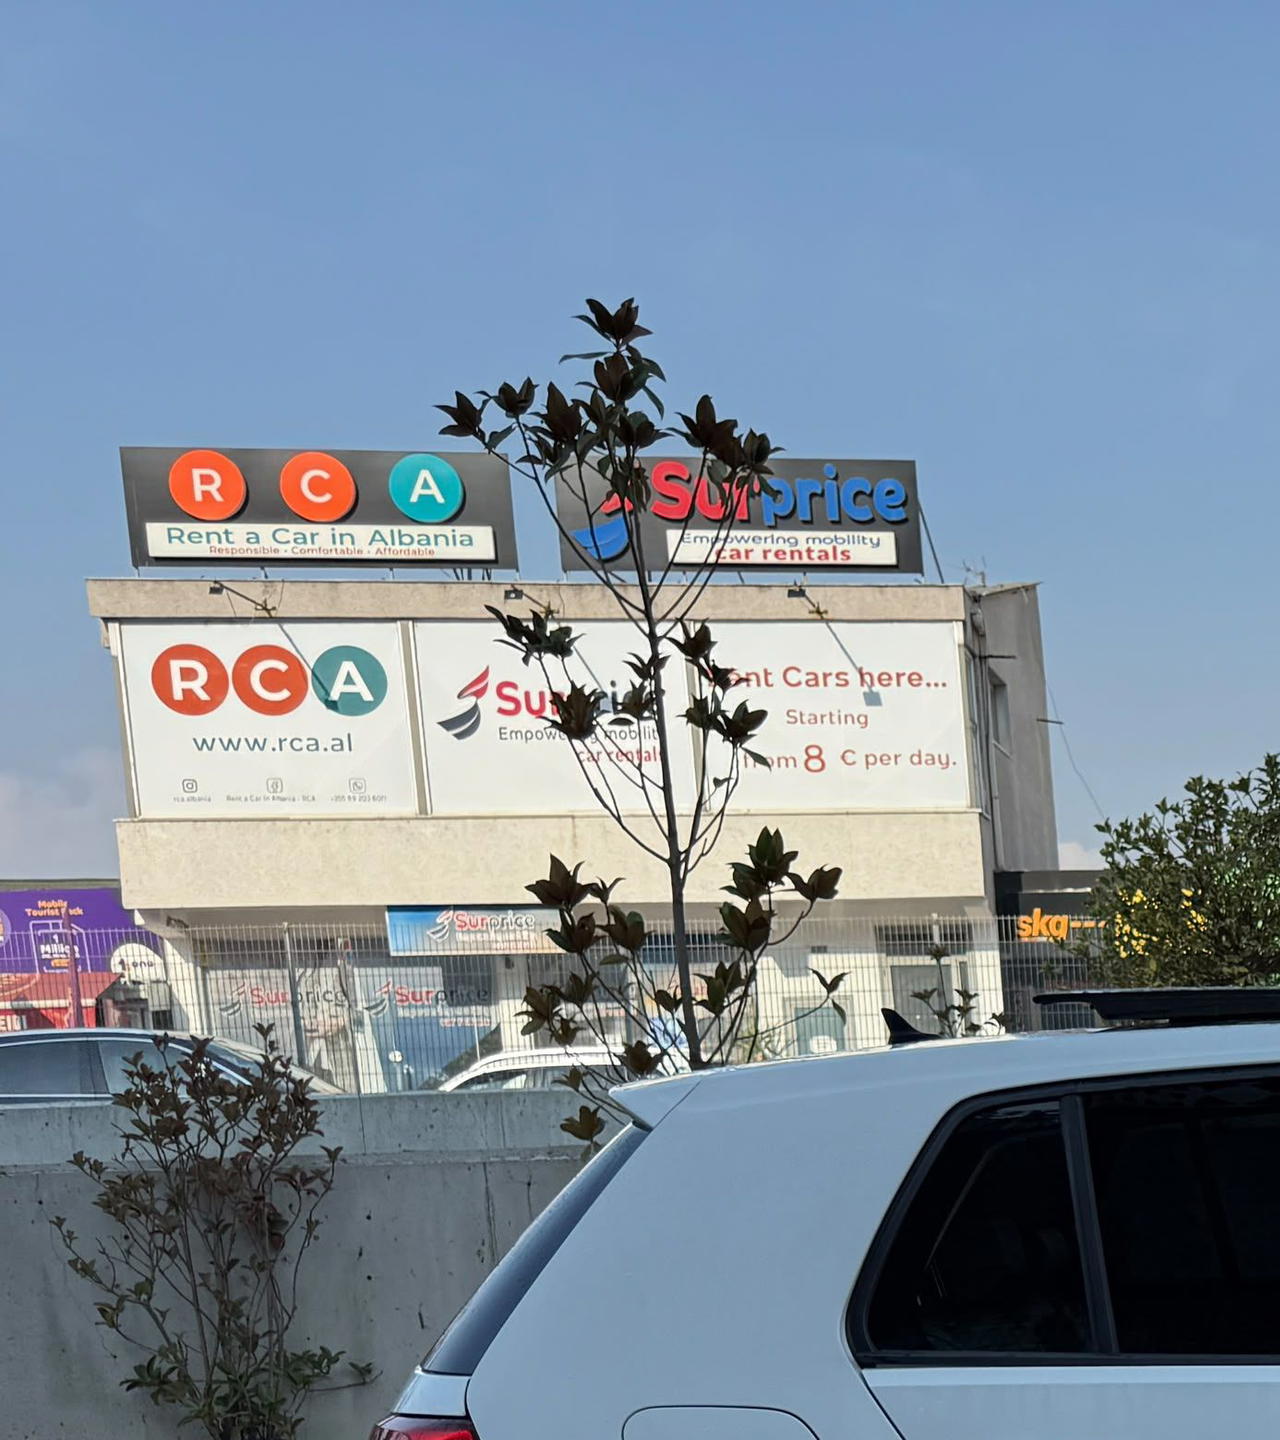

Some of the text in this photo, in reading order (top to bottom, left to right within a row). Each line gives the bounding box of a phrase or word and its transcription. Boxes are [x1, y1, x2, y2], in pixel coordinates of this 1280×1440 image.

[651, 460, 907, 527] Surprice
[166, 527, 474, 547] Rent a Car in Albania
[681, 533, 881, 548] Empowering mobility
[209, 545, 436, 556] Responsible Comfortable Affordable
[715, 545, 851, 561] car rentals
[782, 666, 849, 688] Cars
[858, 667, 947, 688] here...
[786, 709, 869, 728] Starting
[192, 733, 353, 753] www.rca.al
[499, 727, 598, 743] Empoweg
[607, 746, 661, 762] rental
[803, 744, 826, 773] 8
[864, 751, 902, 770] per
[909, 750, 957, 770] day.
